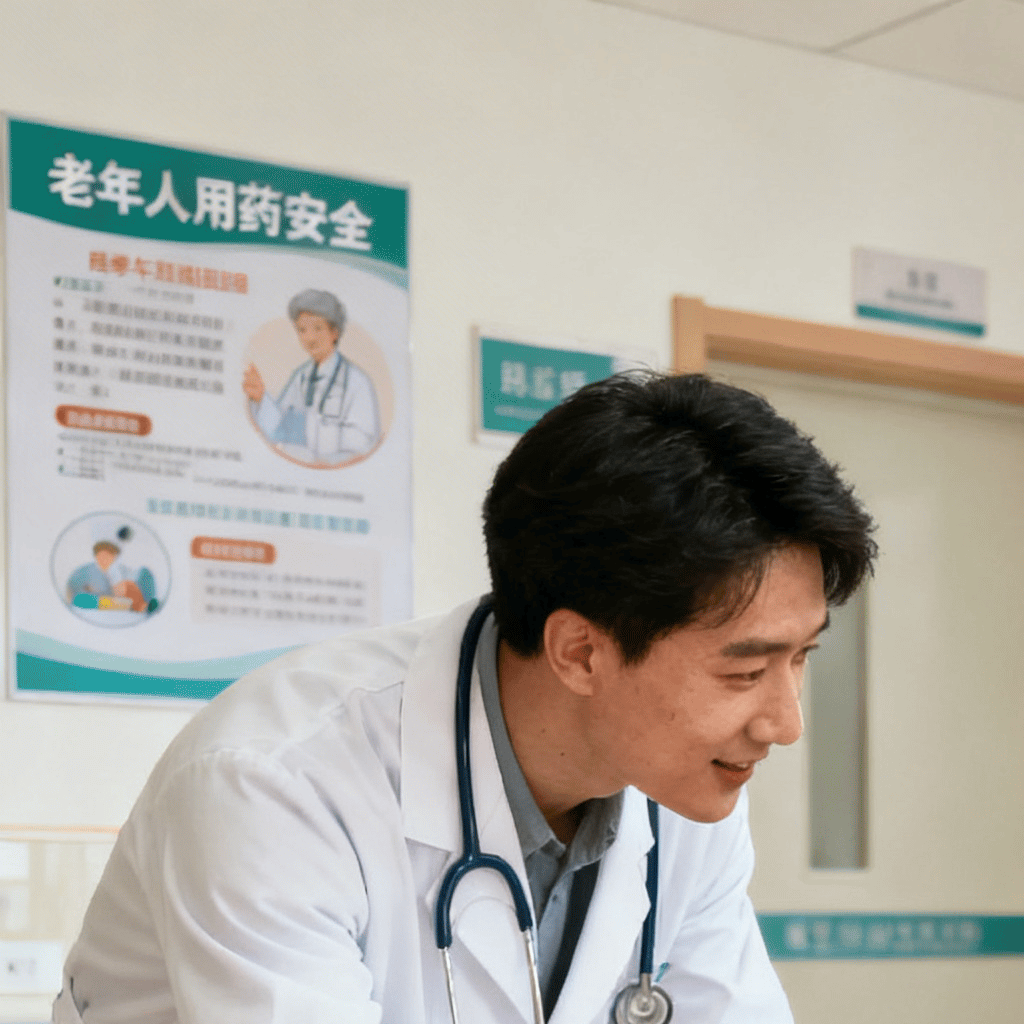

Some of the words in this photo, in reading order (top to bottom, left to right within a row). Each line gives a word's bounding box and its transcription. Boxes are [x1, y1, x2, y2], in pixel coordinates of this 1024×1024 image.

[48, 153, 373, 250] 老年人用药安全
